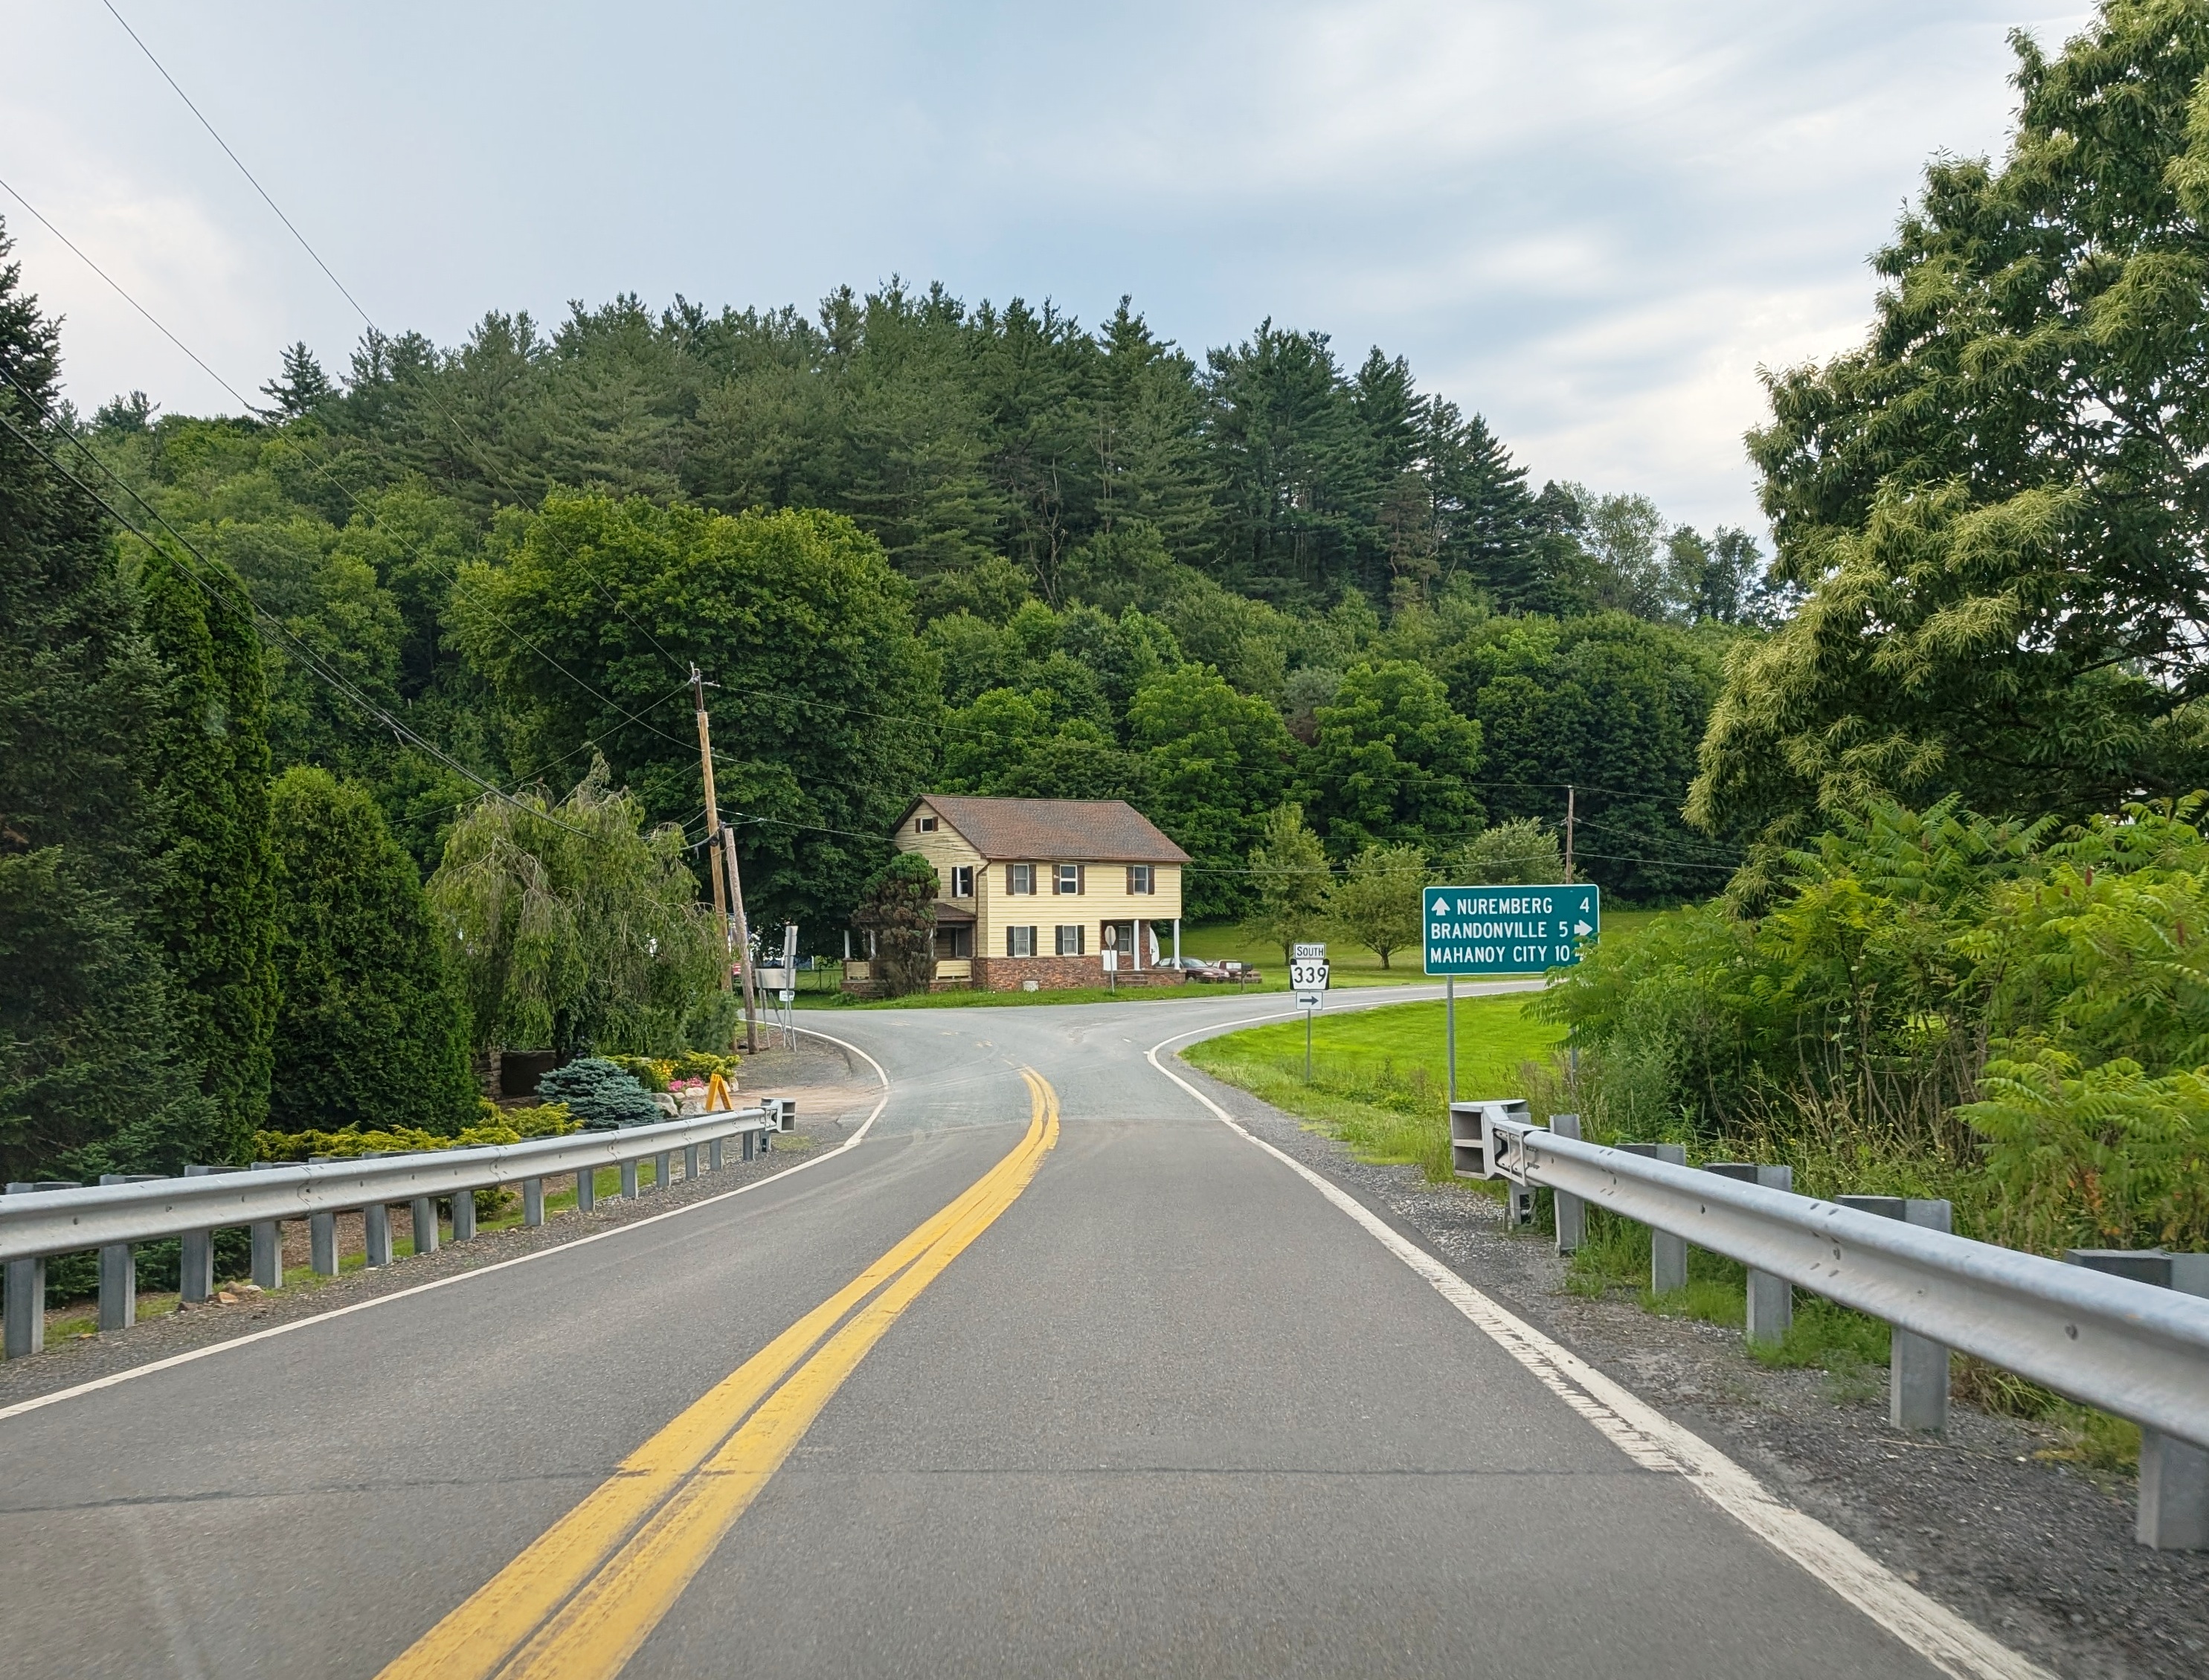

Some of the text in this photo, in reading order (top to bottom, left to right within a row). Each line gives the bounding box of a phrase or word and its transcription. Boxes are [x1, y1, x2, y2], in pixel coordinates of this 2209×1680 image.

[1457, 897, 1590, 915] NUREMBERG 4
[1431, 921, 1569, 939] BRANDONVILLE 5
[1296, 946, 1324, 956] SOUTH
[1430, 945, 1570, 963] MAHANOY CITY 10
[1293, 966, 1326, 984] 339
